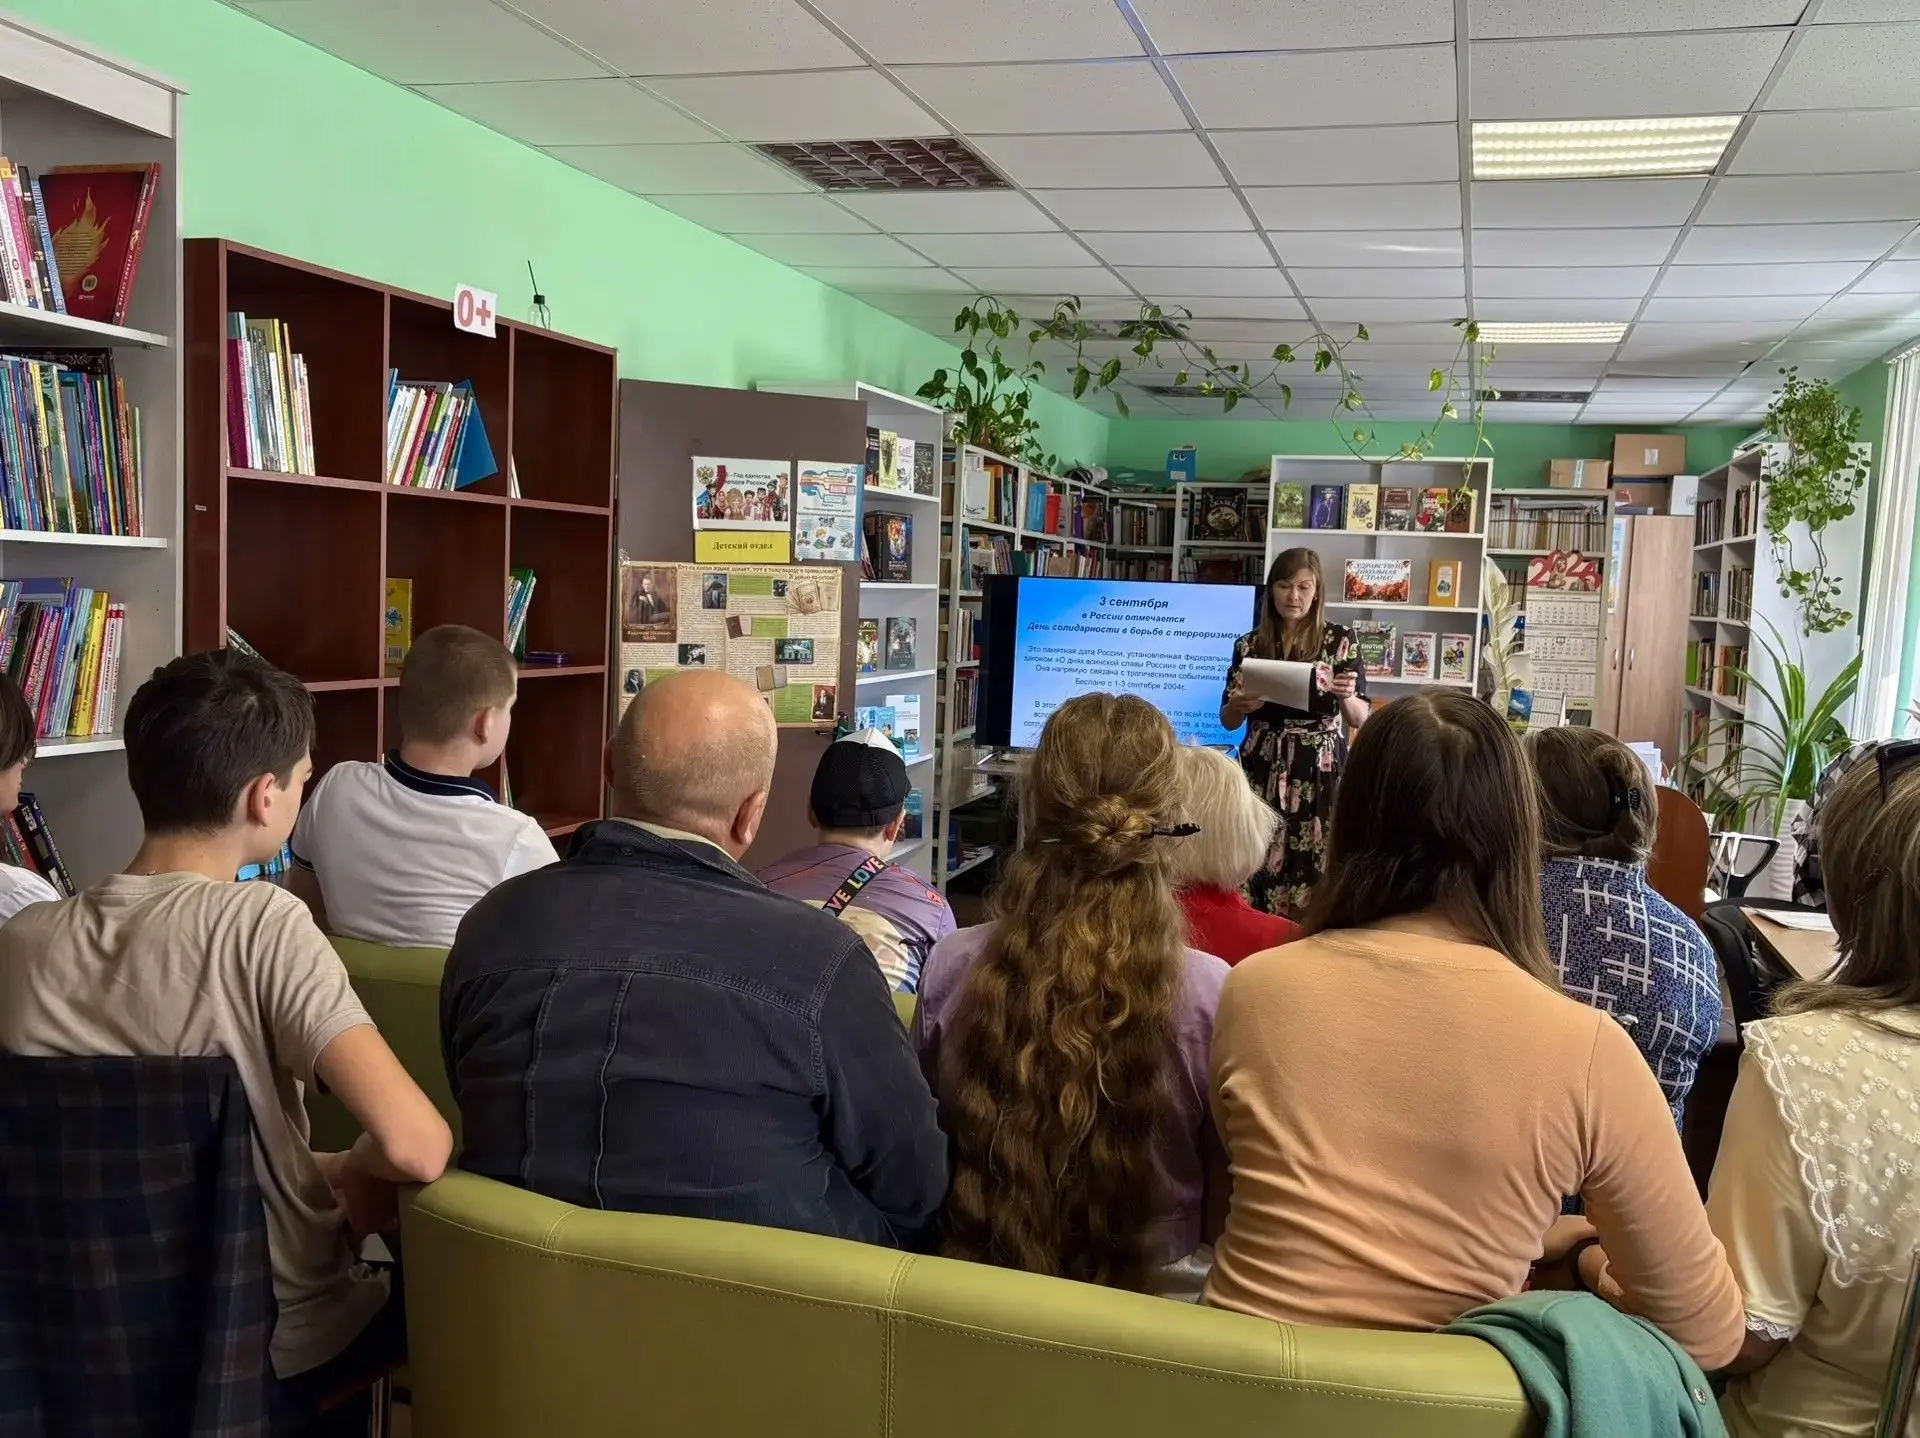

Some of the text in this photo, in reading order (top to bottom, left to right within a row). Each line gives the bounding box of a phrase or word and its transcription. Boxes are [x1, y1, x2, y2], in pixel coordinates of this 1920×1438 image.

[458, 289, 491, 327] 0+
[712, 541, 773, 551] Детский отдел
[1099, 596, 1169, 610] 3 сентября
[1089, 611, 1122, 621] России
[1124, 614, 1186, 624] отмечается
[1027, 621, 1050, 632] День
[1052, 623, 1120, 635] солидарности
[1129, 626, 1164, 637] борьбе
[1173, 630, 1241, 641] терроризмом
[1027, 645, 1042, 653] Это
[1077, 648, 1095, 656] дата
[1096, 649, 1126, 658] России,
[1126, 650, 1182, 660] установленная
[1066, 657, 1085, 665] днях
[1085, 659, 1119, 667] воинской
[1120, 660, 1144, 668] славы
[1035, 664, 1051, 672] Она
[1051, 666, 1088, 675] напрямую
[1089, 668, 1119, 676] связана
[1075, 677, 1106, 686] Беслане
[1034, 700, 1041, 708] В
[846, 857, 885, 890] LOVE
